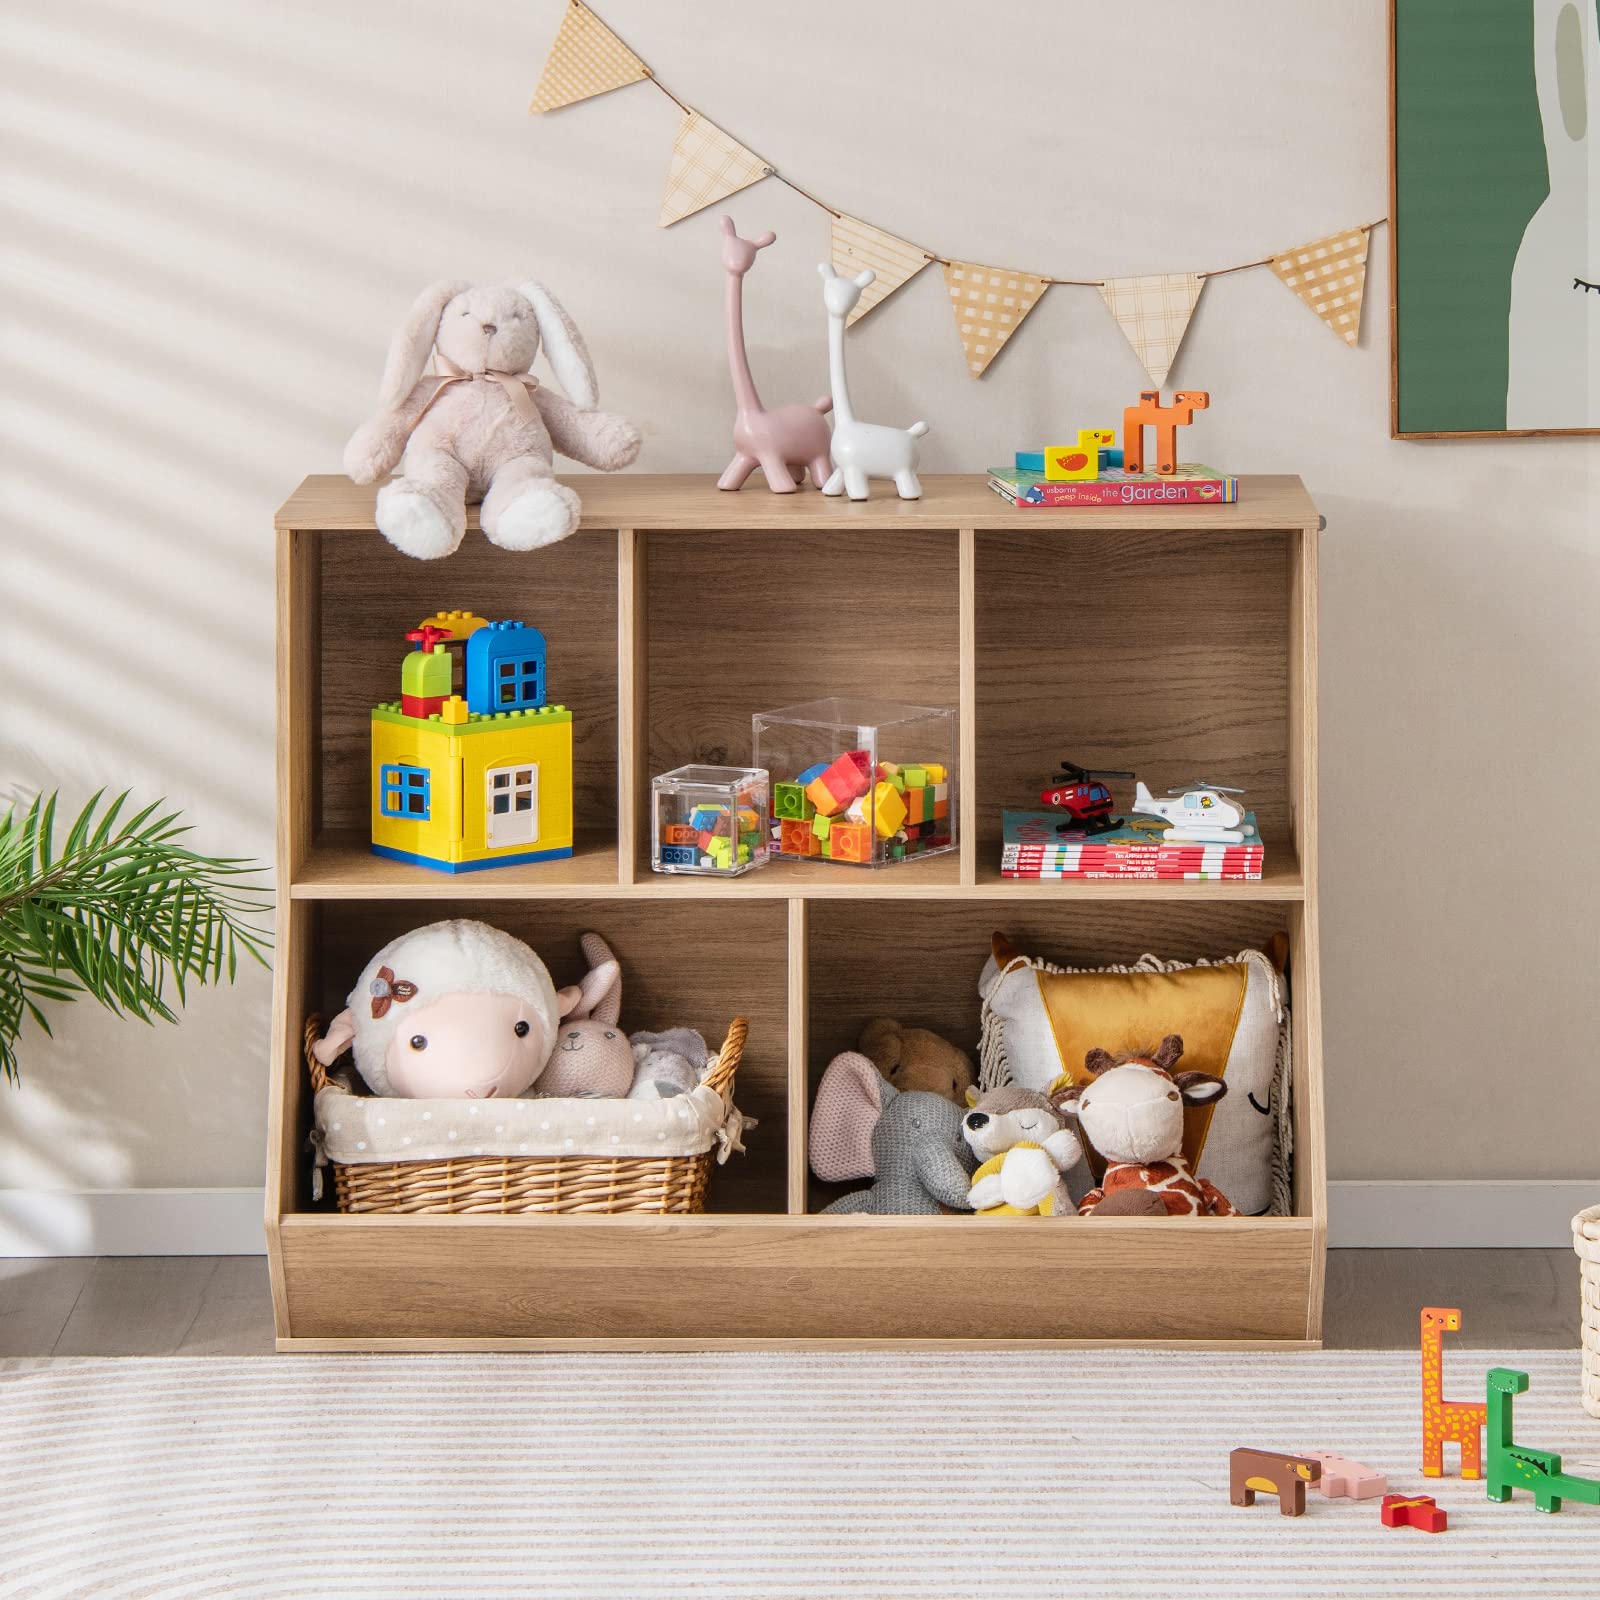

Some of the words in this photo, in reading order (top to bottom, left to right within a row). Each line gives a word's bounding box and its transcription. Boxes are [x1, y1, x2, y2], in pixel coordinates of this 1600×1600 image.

[1046, 486, 1077, 494] usborne
[1102, 487, 1118, 497] the
[1121, 482, 1188, 503] garden
[1054, 494, 1076, 504] peep
[1078, 492, 1102, 503] inside
